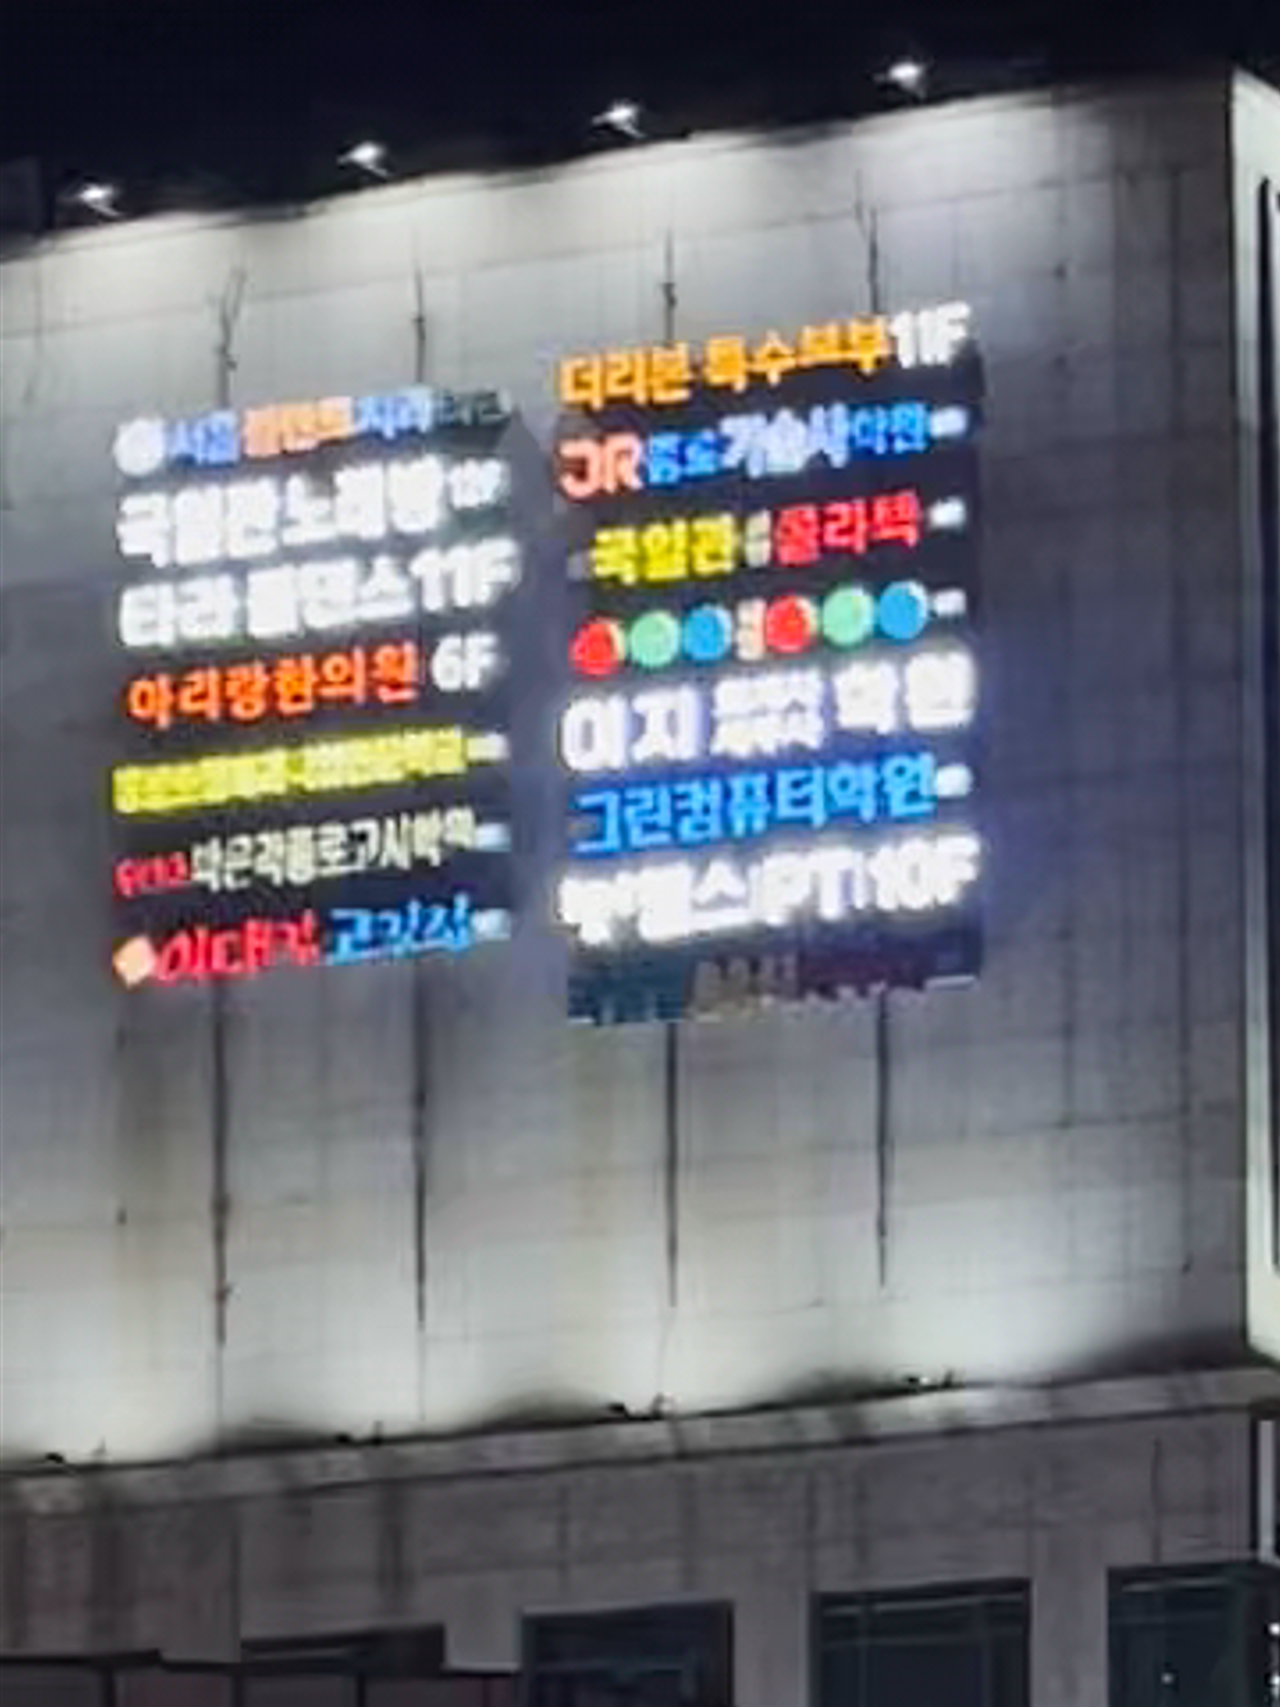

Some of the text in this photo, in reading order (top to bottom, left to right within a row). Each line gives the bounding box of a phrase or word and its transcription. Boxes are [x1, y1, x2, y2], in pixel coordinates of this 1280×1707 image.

[127, 632, 500, 731] 아리랑한의원 6F
[576, 751, 937, 853] 그린컴퓨터학원
